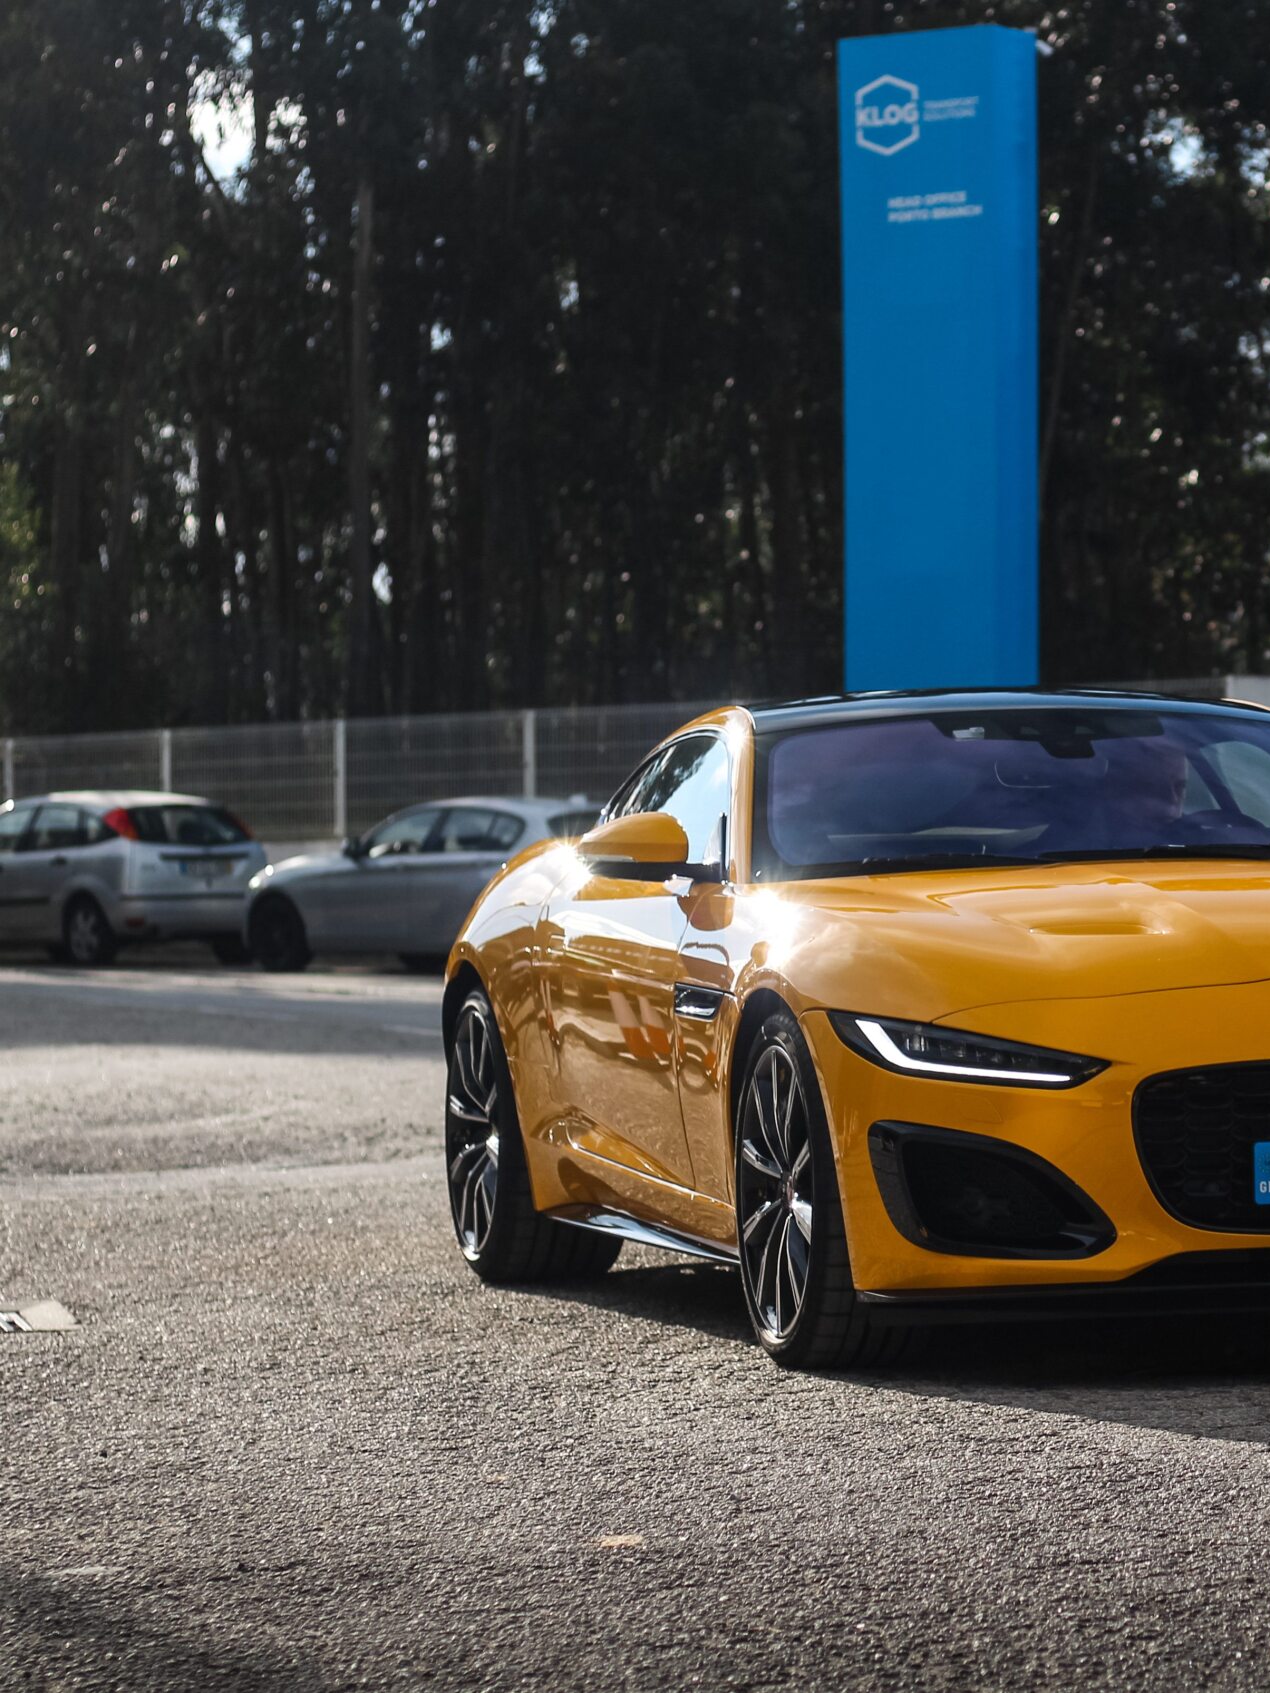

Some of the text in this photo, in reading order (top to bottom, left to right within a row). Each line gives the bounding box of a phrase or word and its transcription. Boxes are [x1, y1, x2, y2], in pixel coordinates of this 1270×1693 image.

[856, 102, 919, 127] KLOG
[924, 190, 967, 205] OFFICE
[932, 204, 983, 219] BRANCH
